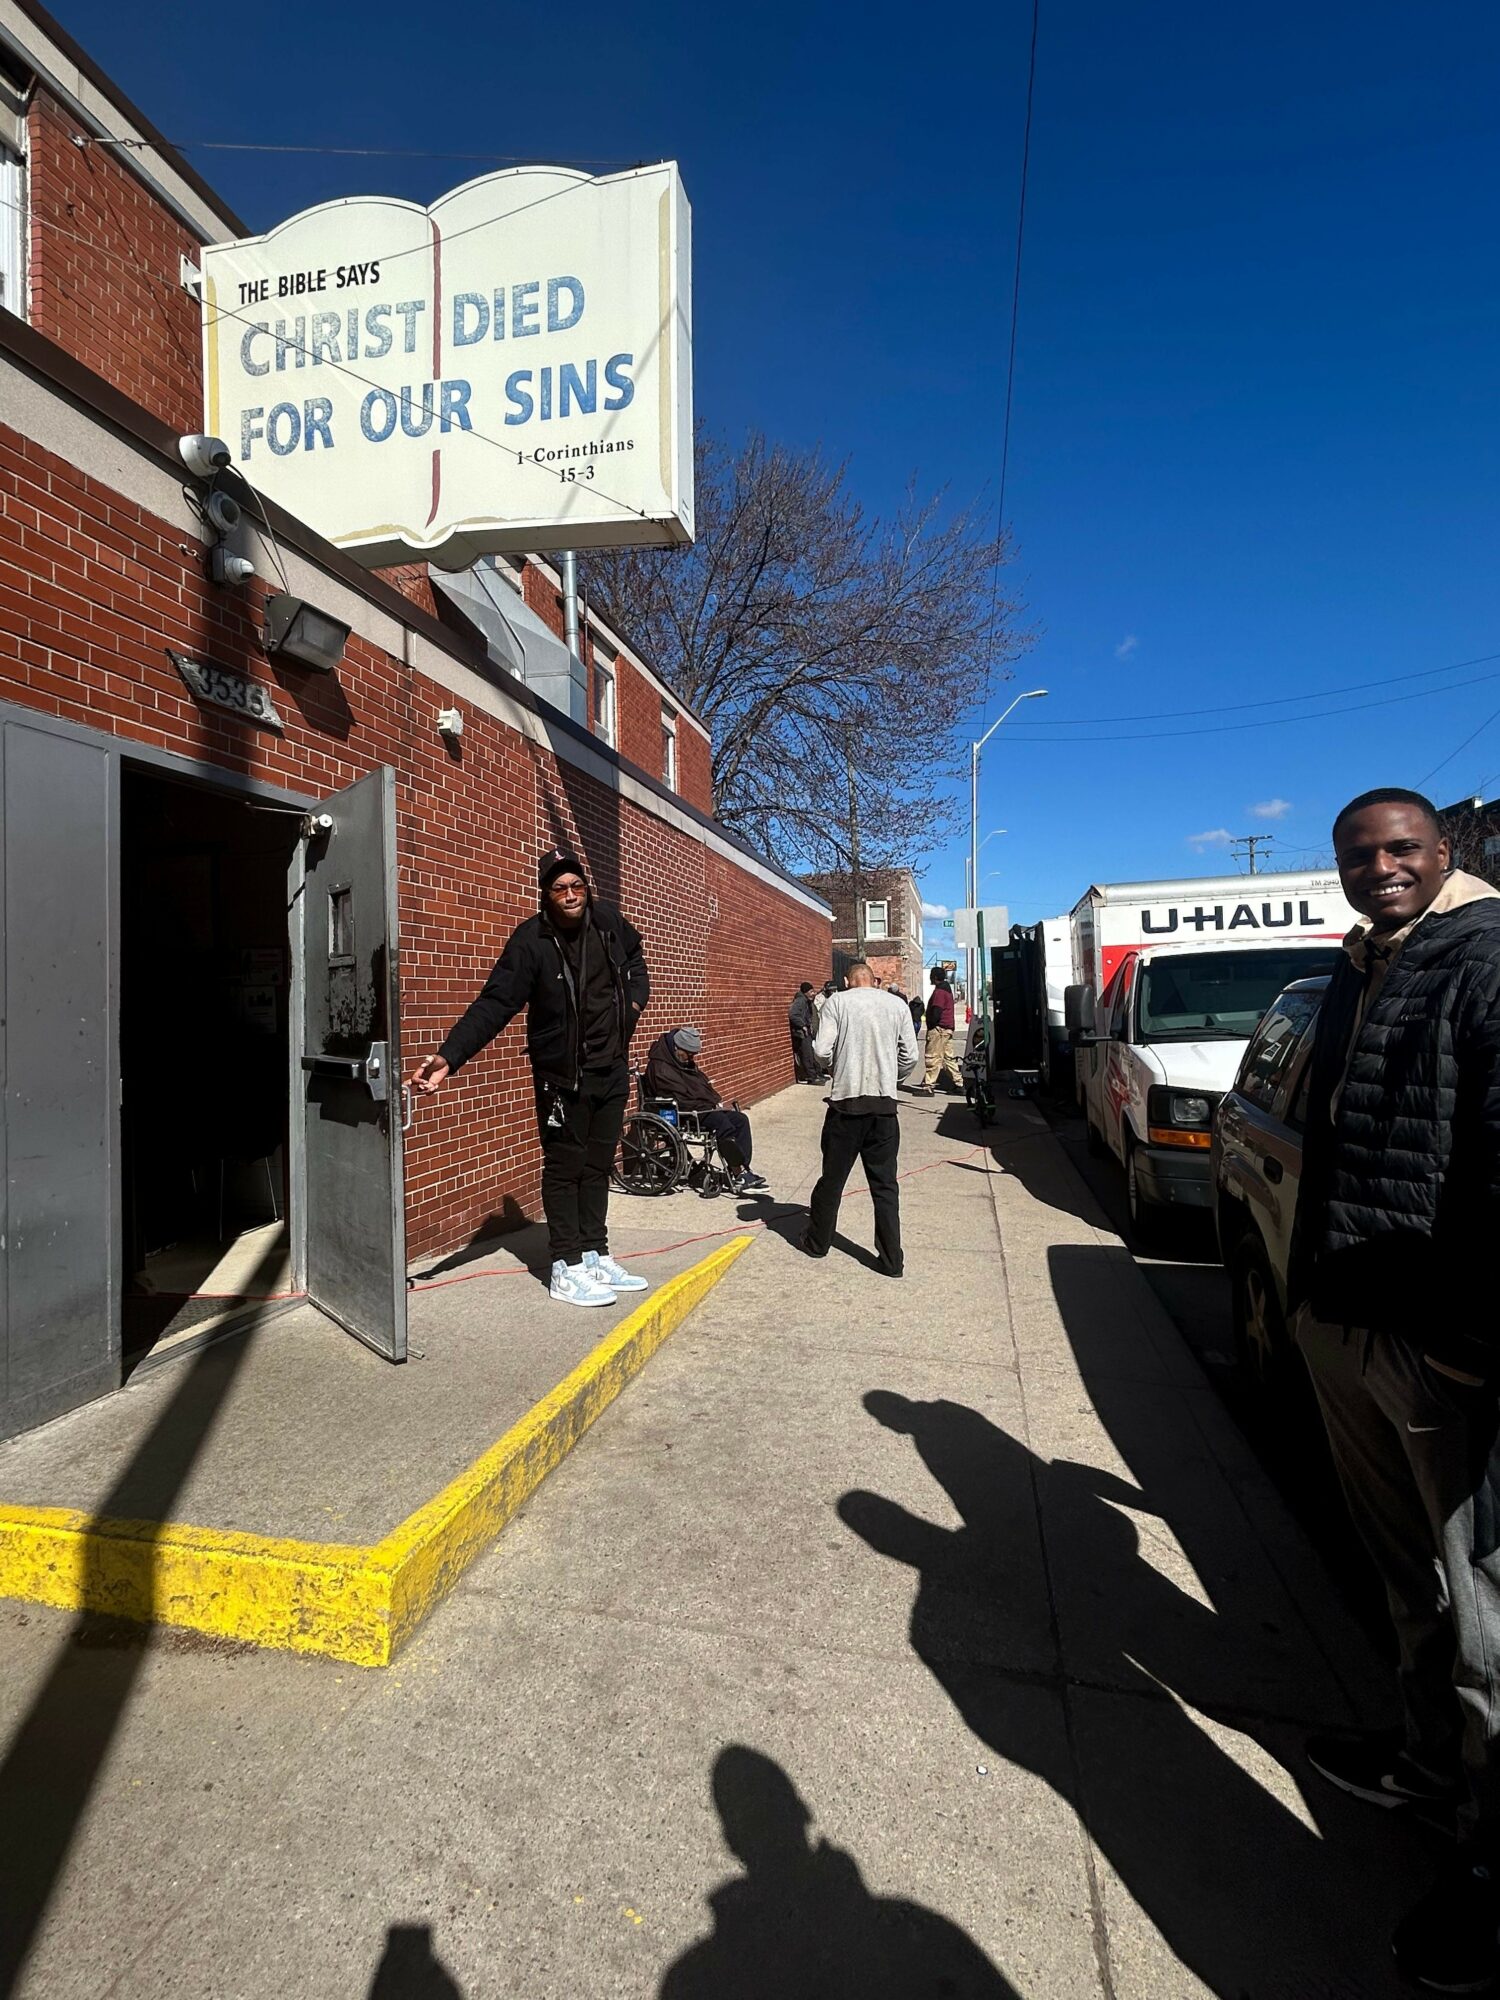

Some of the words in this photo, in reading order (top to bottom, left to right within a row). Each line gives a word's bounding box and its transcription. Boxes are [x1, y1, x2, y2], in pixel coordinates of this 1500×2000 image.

[238, 278, 269, 305] THE
[278, 269, 327, 298] BIBLE
[336, 261, 381, 289] SAYS
[240, 299, 426, 377] CHRIST
[453, 275, 585, 347] DIED
[240, 396, 335, 461] FOR
[360, 378, 473, 443] OUR
[504, 353, 635, 426] SINS
[517, 439, 634, 465] 1-Corinthians
[559, 465, 595, 483] 15-3
[1141, 900, 1325, 935] U-HAUL
